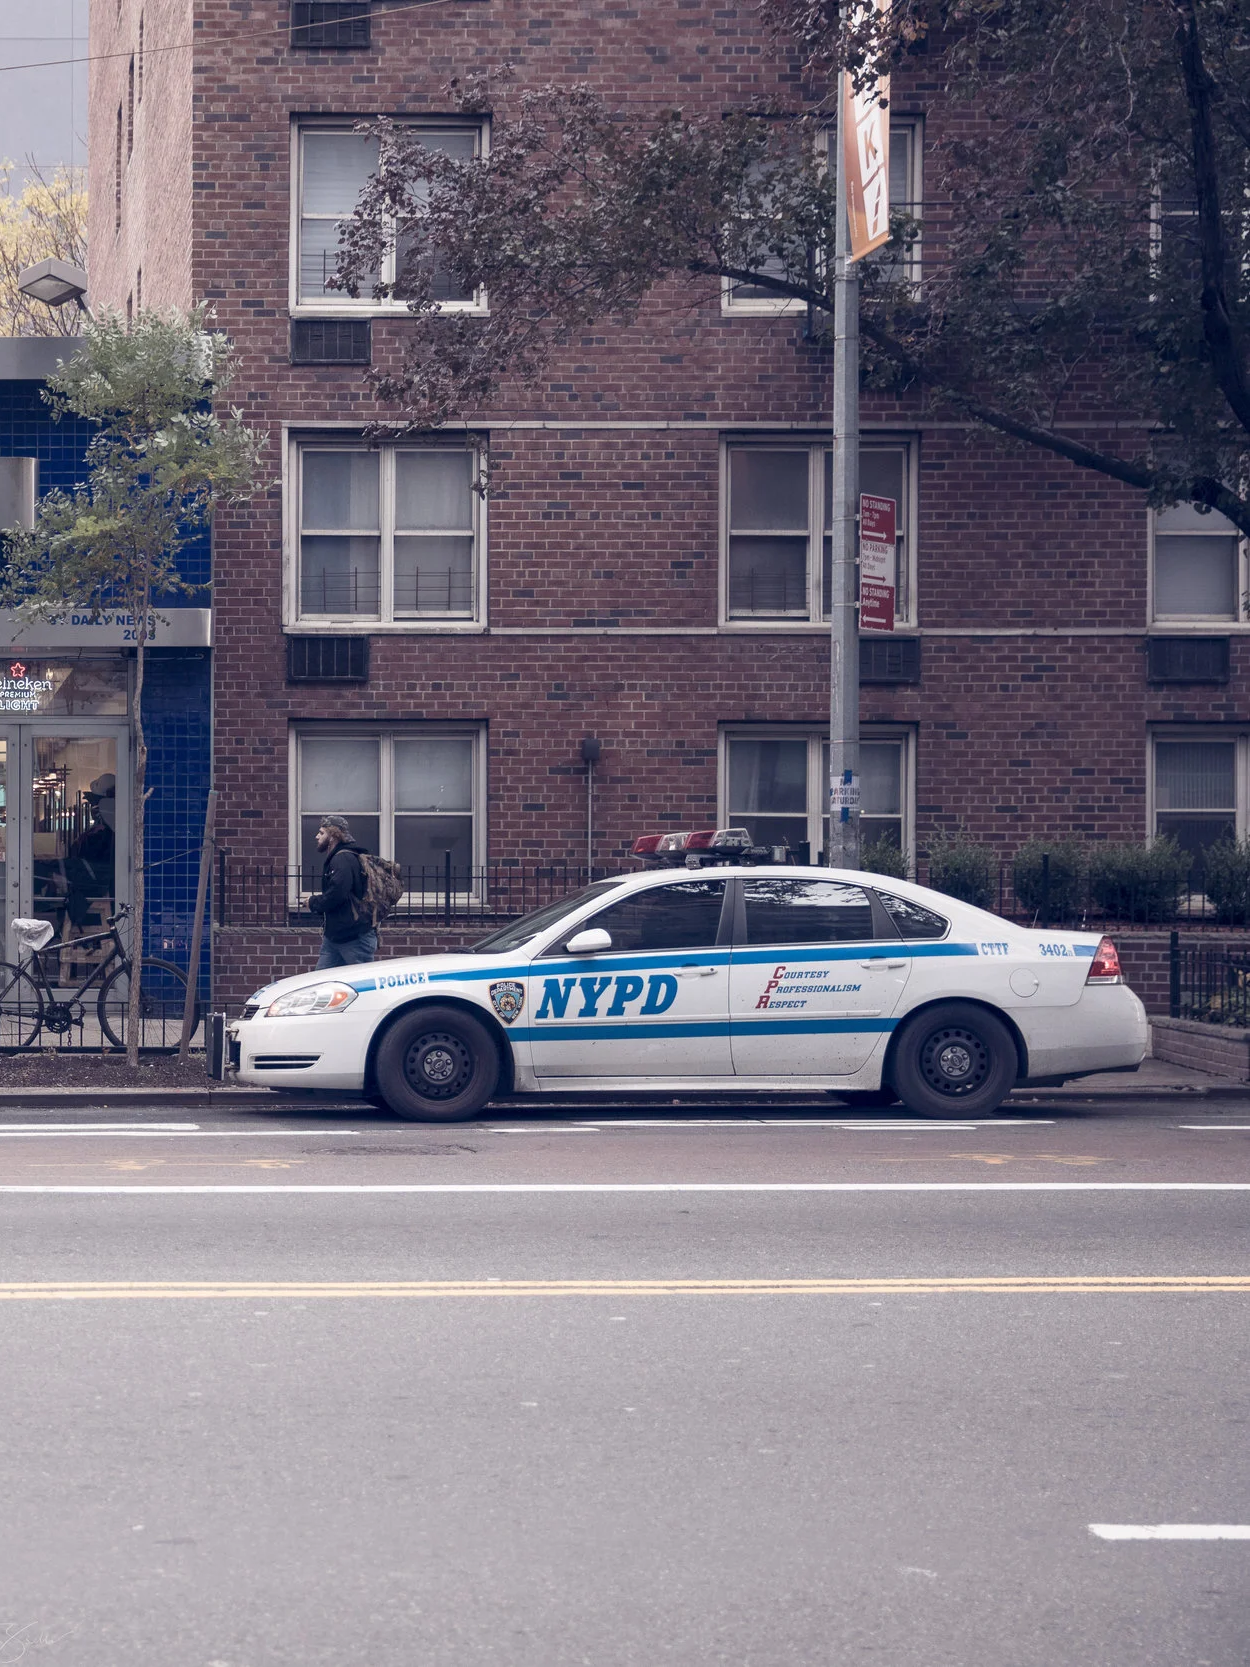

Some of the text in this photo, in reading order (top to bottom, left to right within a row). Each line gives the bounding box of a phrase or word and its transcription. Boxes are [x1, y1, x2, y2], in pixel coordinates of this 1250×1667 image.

[863, 498, 891, 512] NO STANDING
[863, 542, 888, 555] NO PARKING
[863, 586, 890, 599] NO STANDING
[863, 597, 880, 608] Anytime
[71, 614, 112, 626] DALY
[123, 629, 156, 641] 20
[980, 942, 1009, 956] CTTF
[1038, 943, 1068, 957] 3402
[377, 971, 427, 990] POLICE
[534, 973, 679, 1019] NYPD
